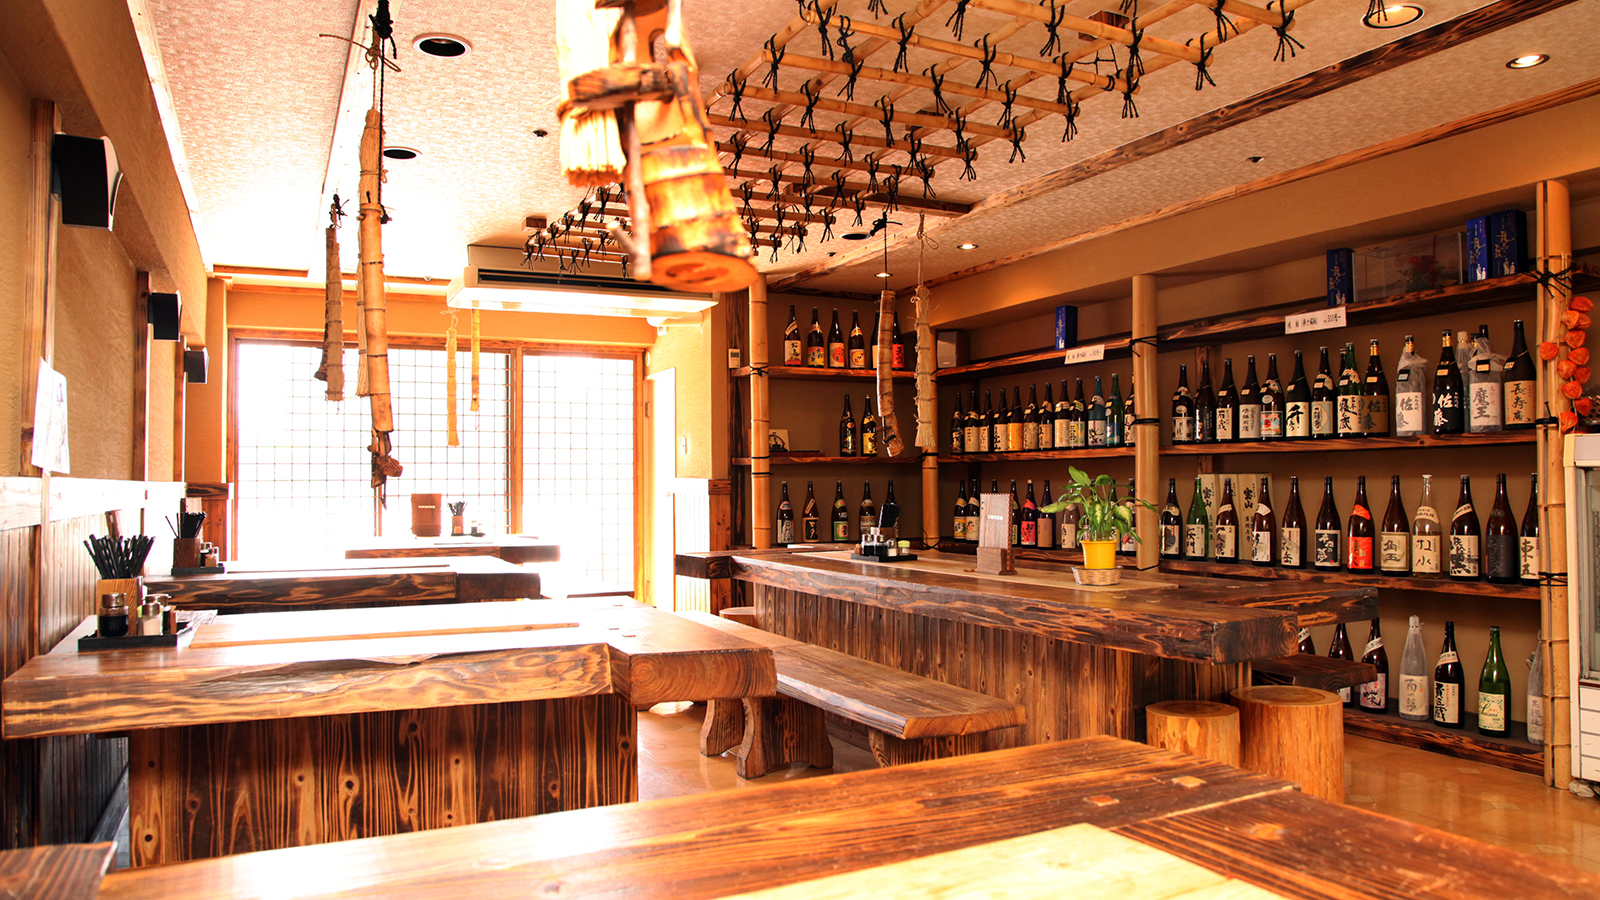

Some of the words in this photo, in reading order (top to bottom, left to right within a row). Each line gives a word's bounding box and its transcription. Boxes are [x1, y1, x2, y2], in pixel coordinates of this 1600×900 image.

[1364, 400, 1381, 430] 佐藤
[1397, 396, 1414, 429] 佐藤
[1433, 393, 1454, 427] 佐藤
[1473, 387, 1490, 419] 魔王
[1383, 540, 1401, 562] 角玉
